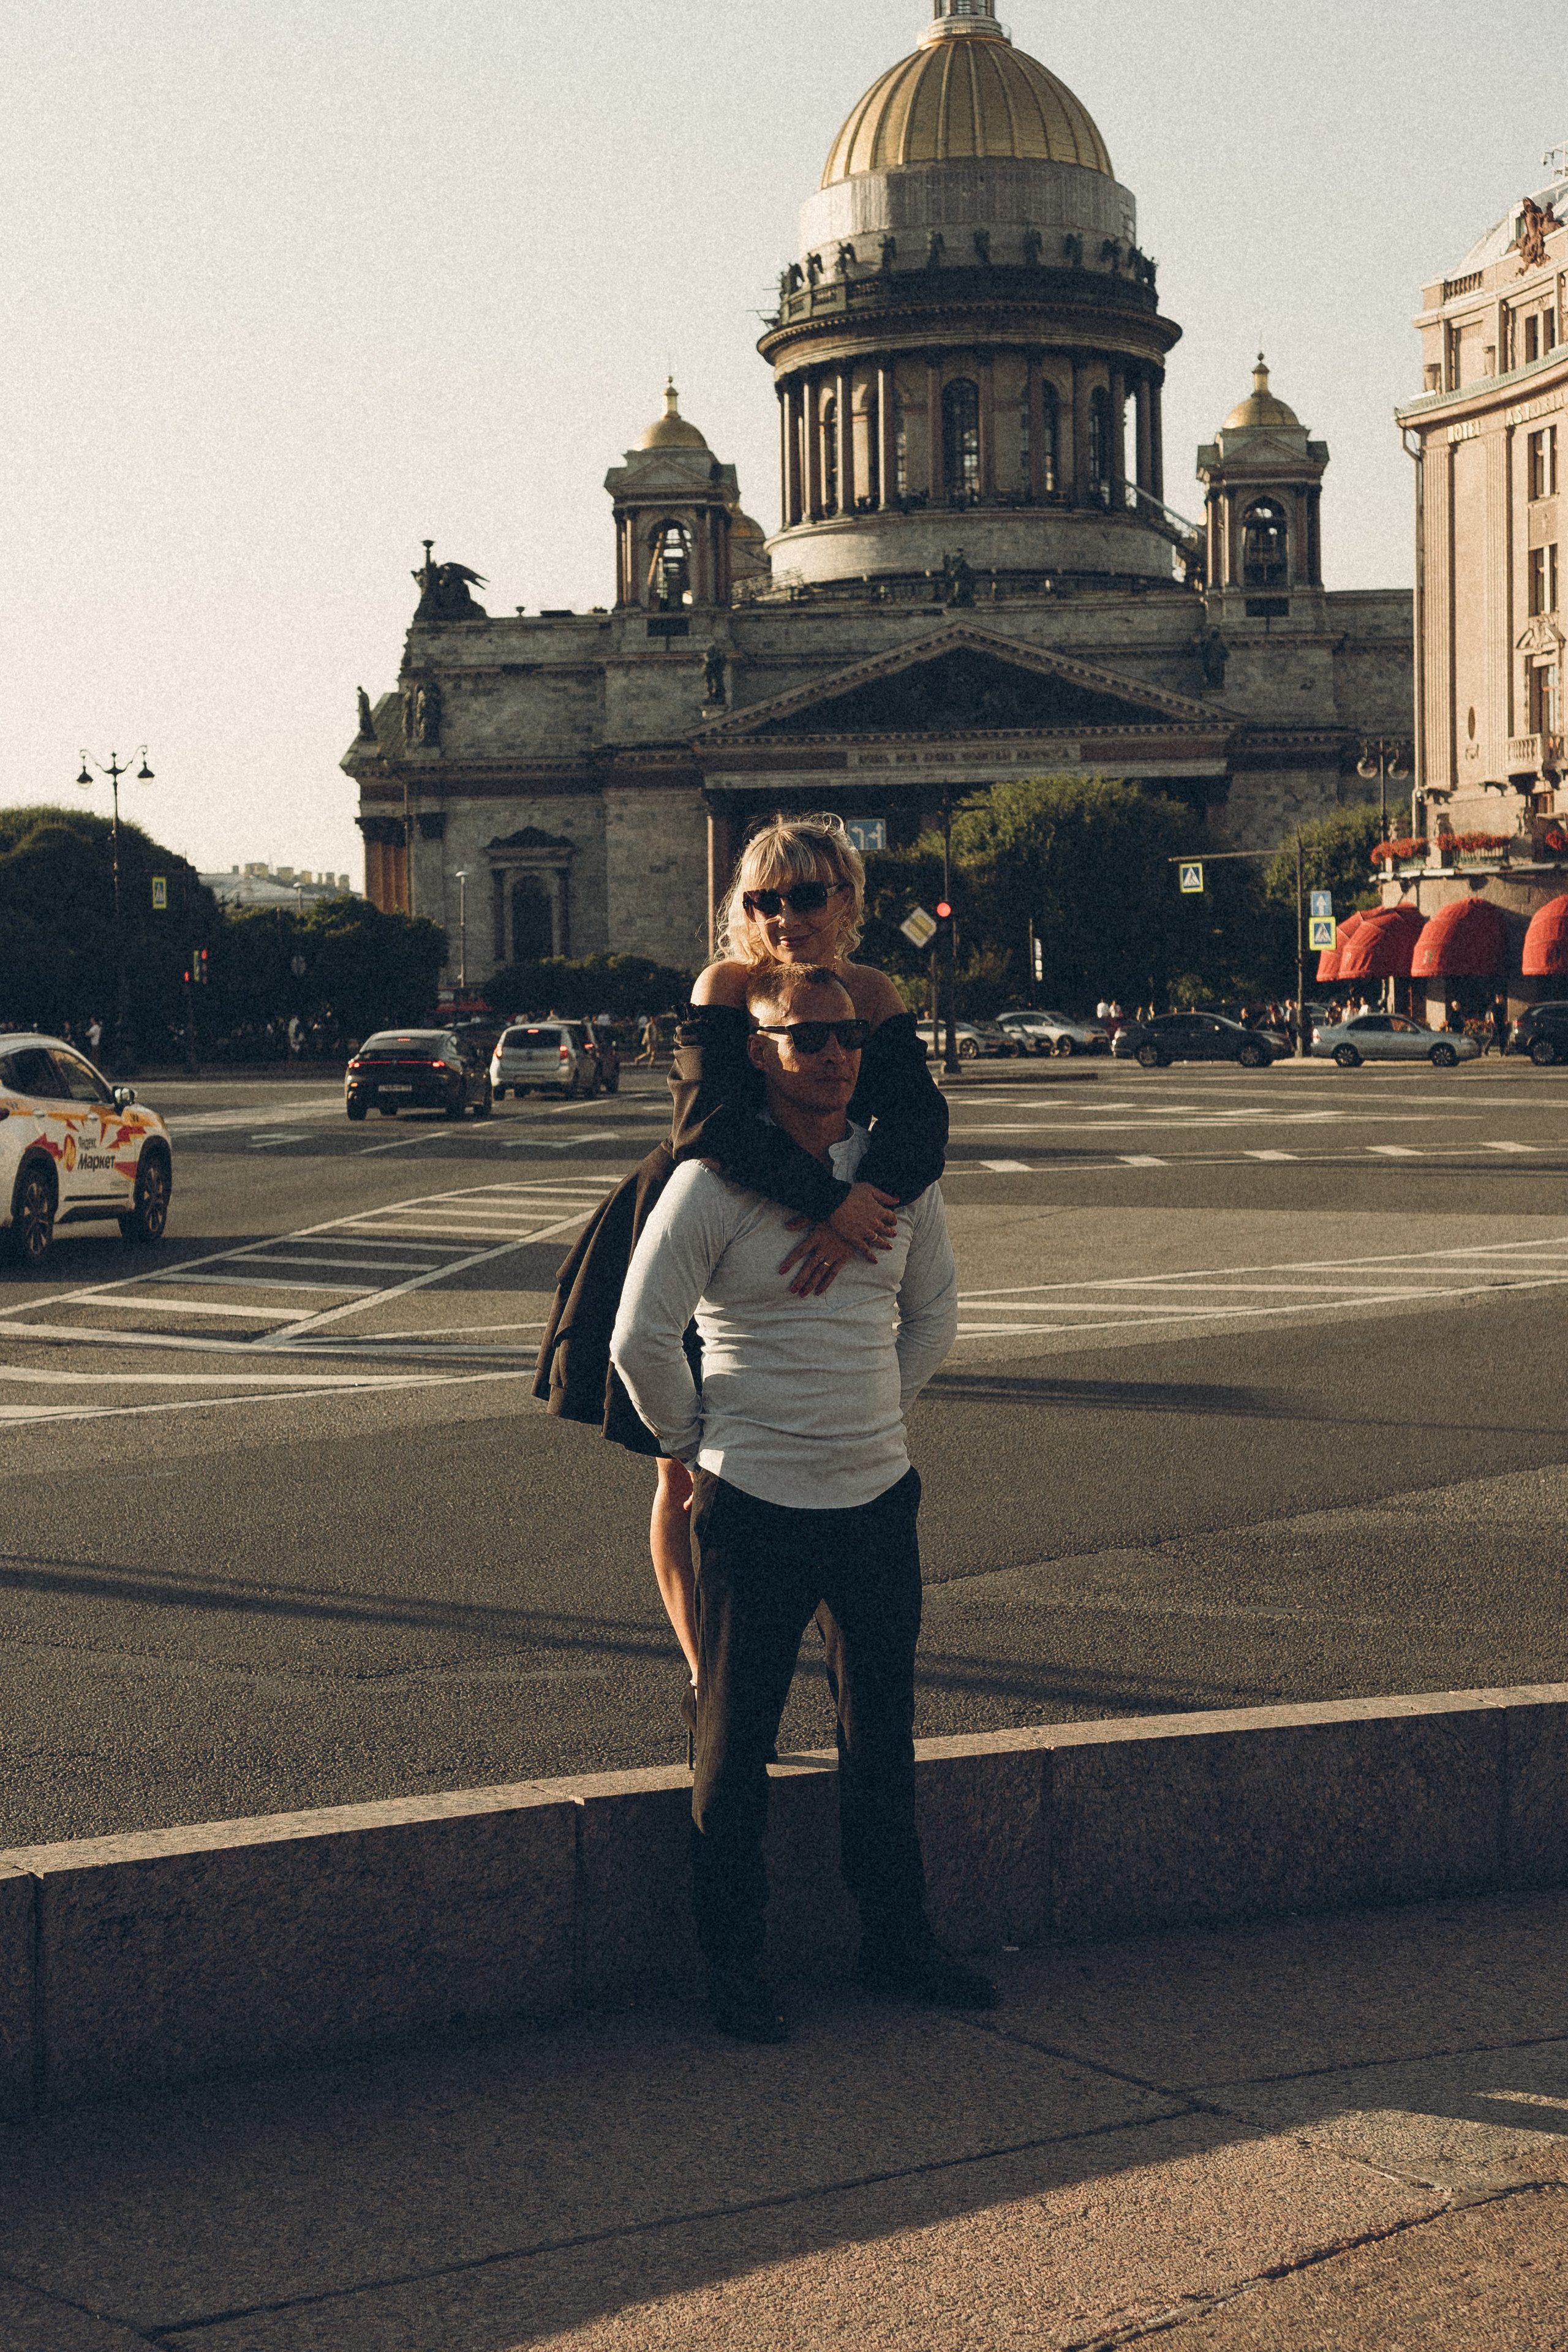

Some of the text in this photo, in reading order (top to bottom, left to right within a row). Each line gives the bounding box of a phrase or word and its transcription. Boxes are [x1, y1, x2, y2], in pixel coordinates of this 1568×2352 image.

[1447, 391, 1564, 443] HOTEL ASTORIA
[78, 1136, 97, 1150] Яндекс
[77, 1153, 116, 1172] Маркет
